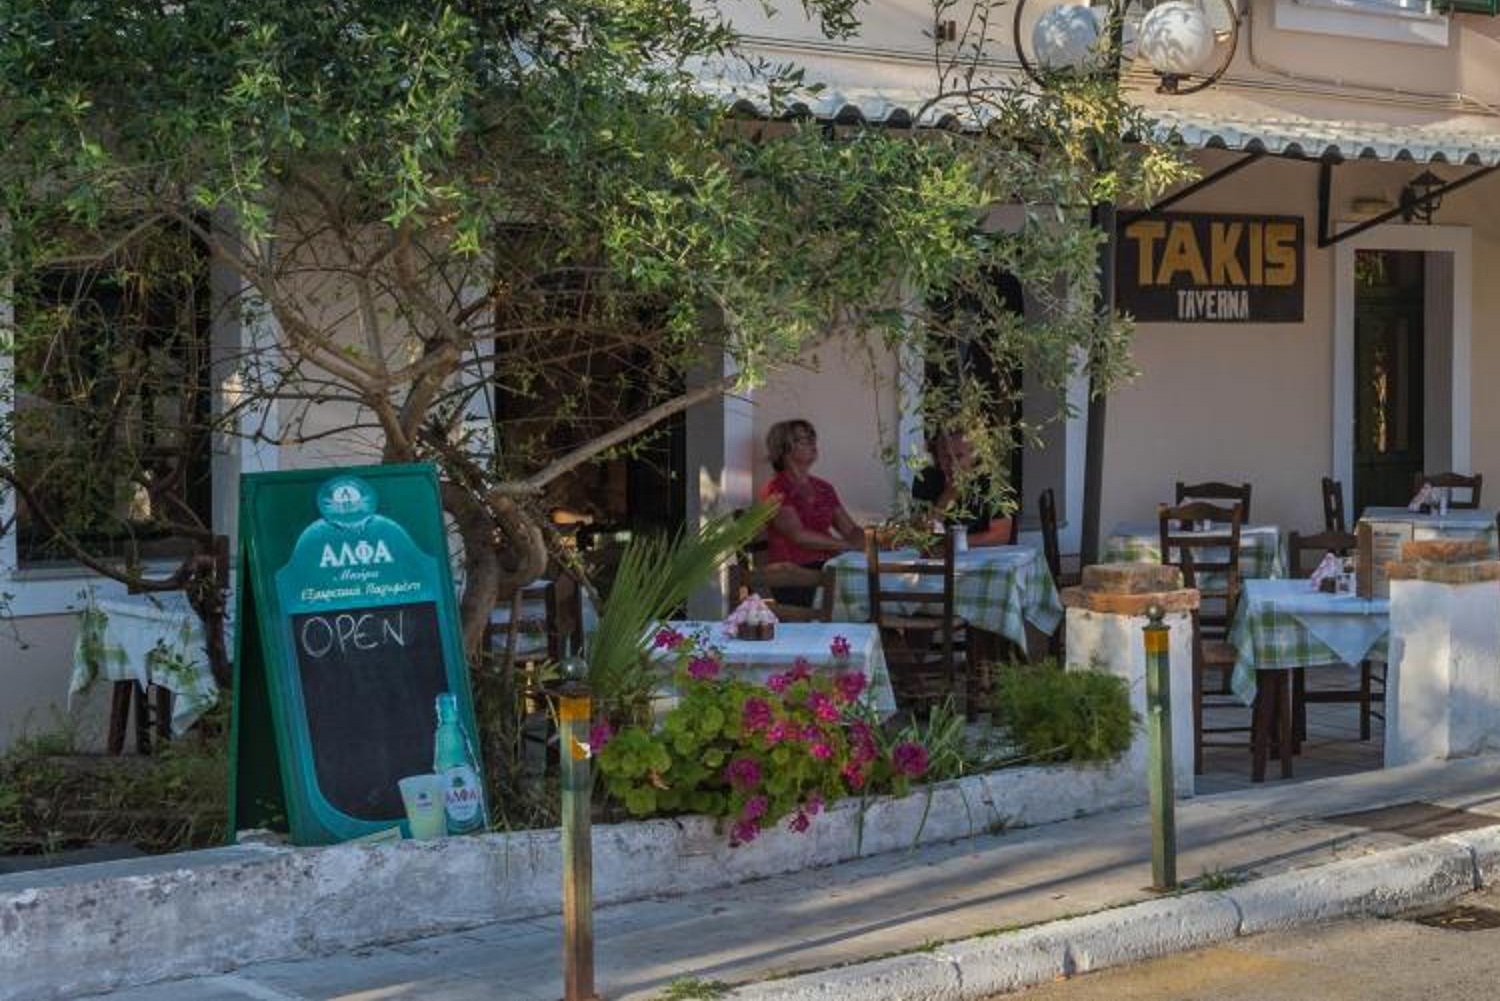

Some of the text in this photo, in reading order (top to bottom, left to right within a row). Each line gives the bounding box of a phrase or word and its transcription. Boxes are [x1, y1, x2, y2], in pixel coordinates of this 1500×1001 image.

[1125, 220, 1298, 286] TAKIS
[1177, 289, 1249, 319] TAVERNA
[319, 539, 395, 568] ΑΛΦΑ
[302, 611, 406, 658] OPEN
